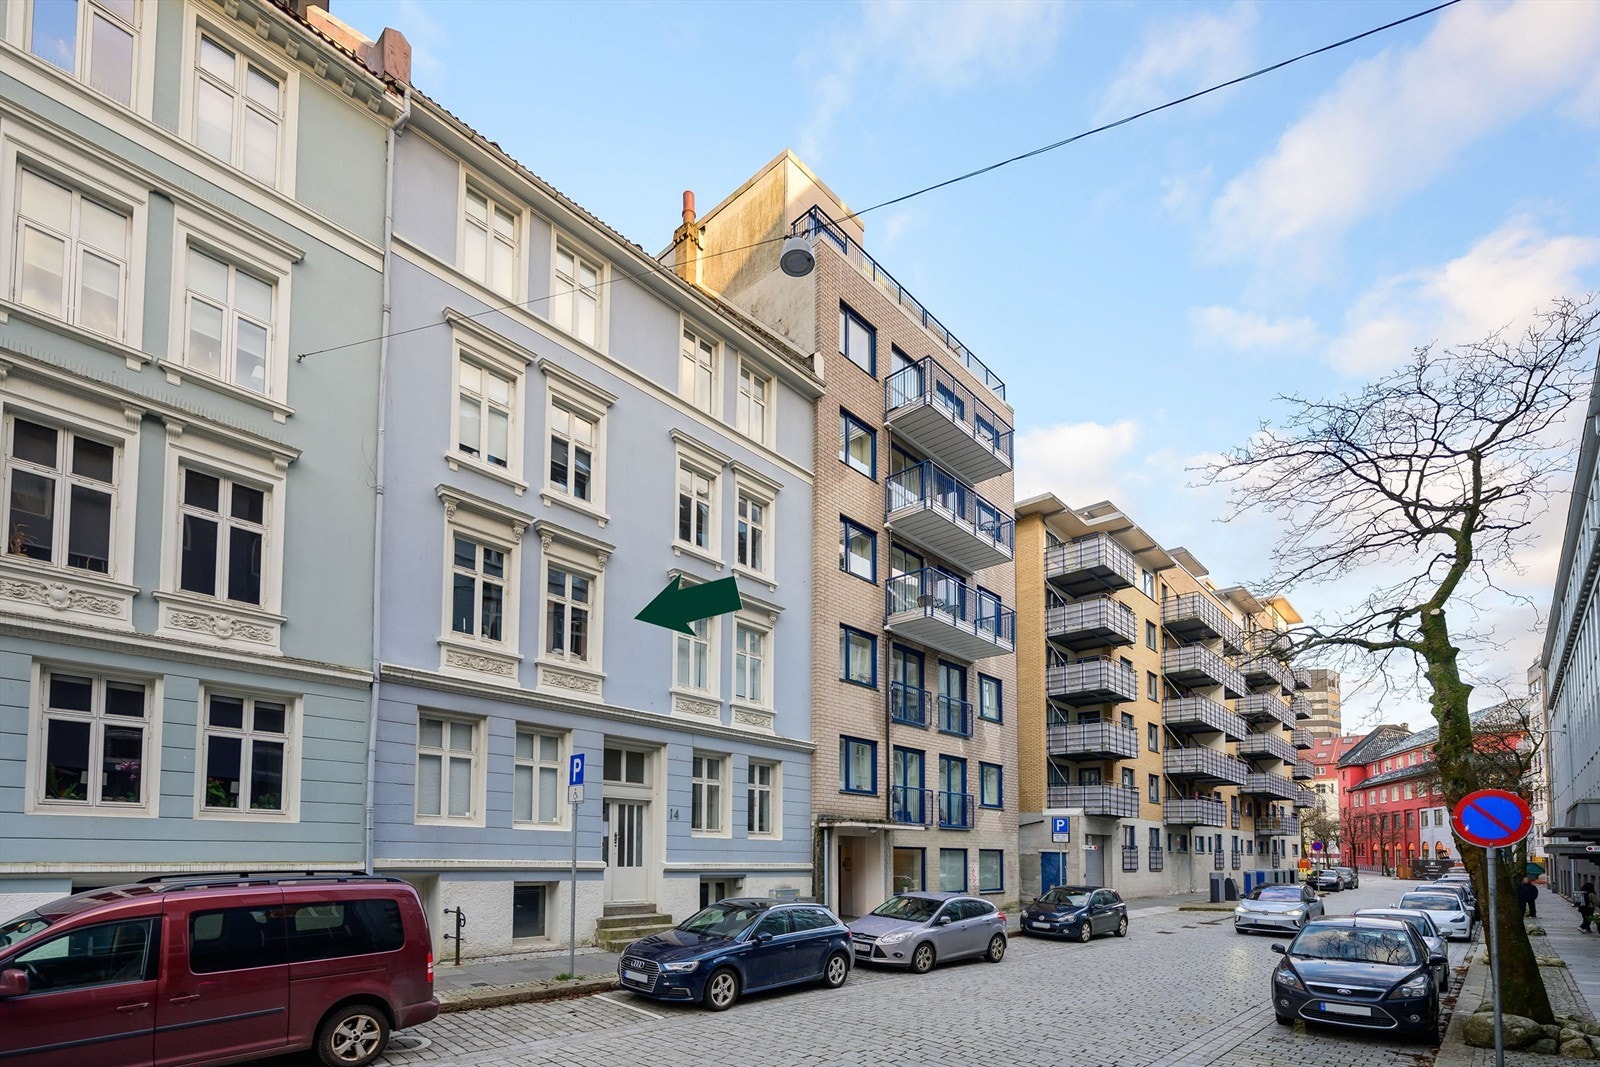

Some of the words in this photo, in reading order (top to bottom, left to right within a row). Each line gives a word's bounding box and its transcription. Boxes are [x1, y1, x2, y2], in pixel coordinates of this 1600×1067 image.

[573, 758, 582, 782] P
[669, 808, 679, 820] 14
[1056, 819, 1065, 831] P
